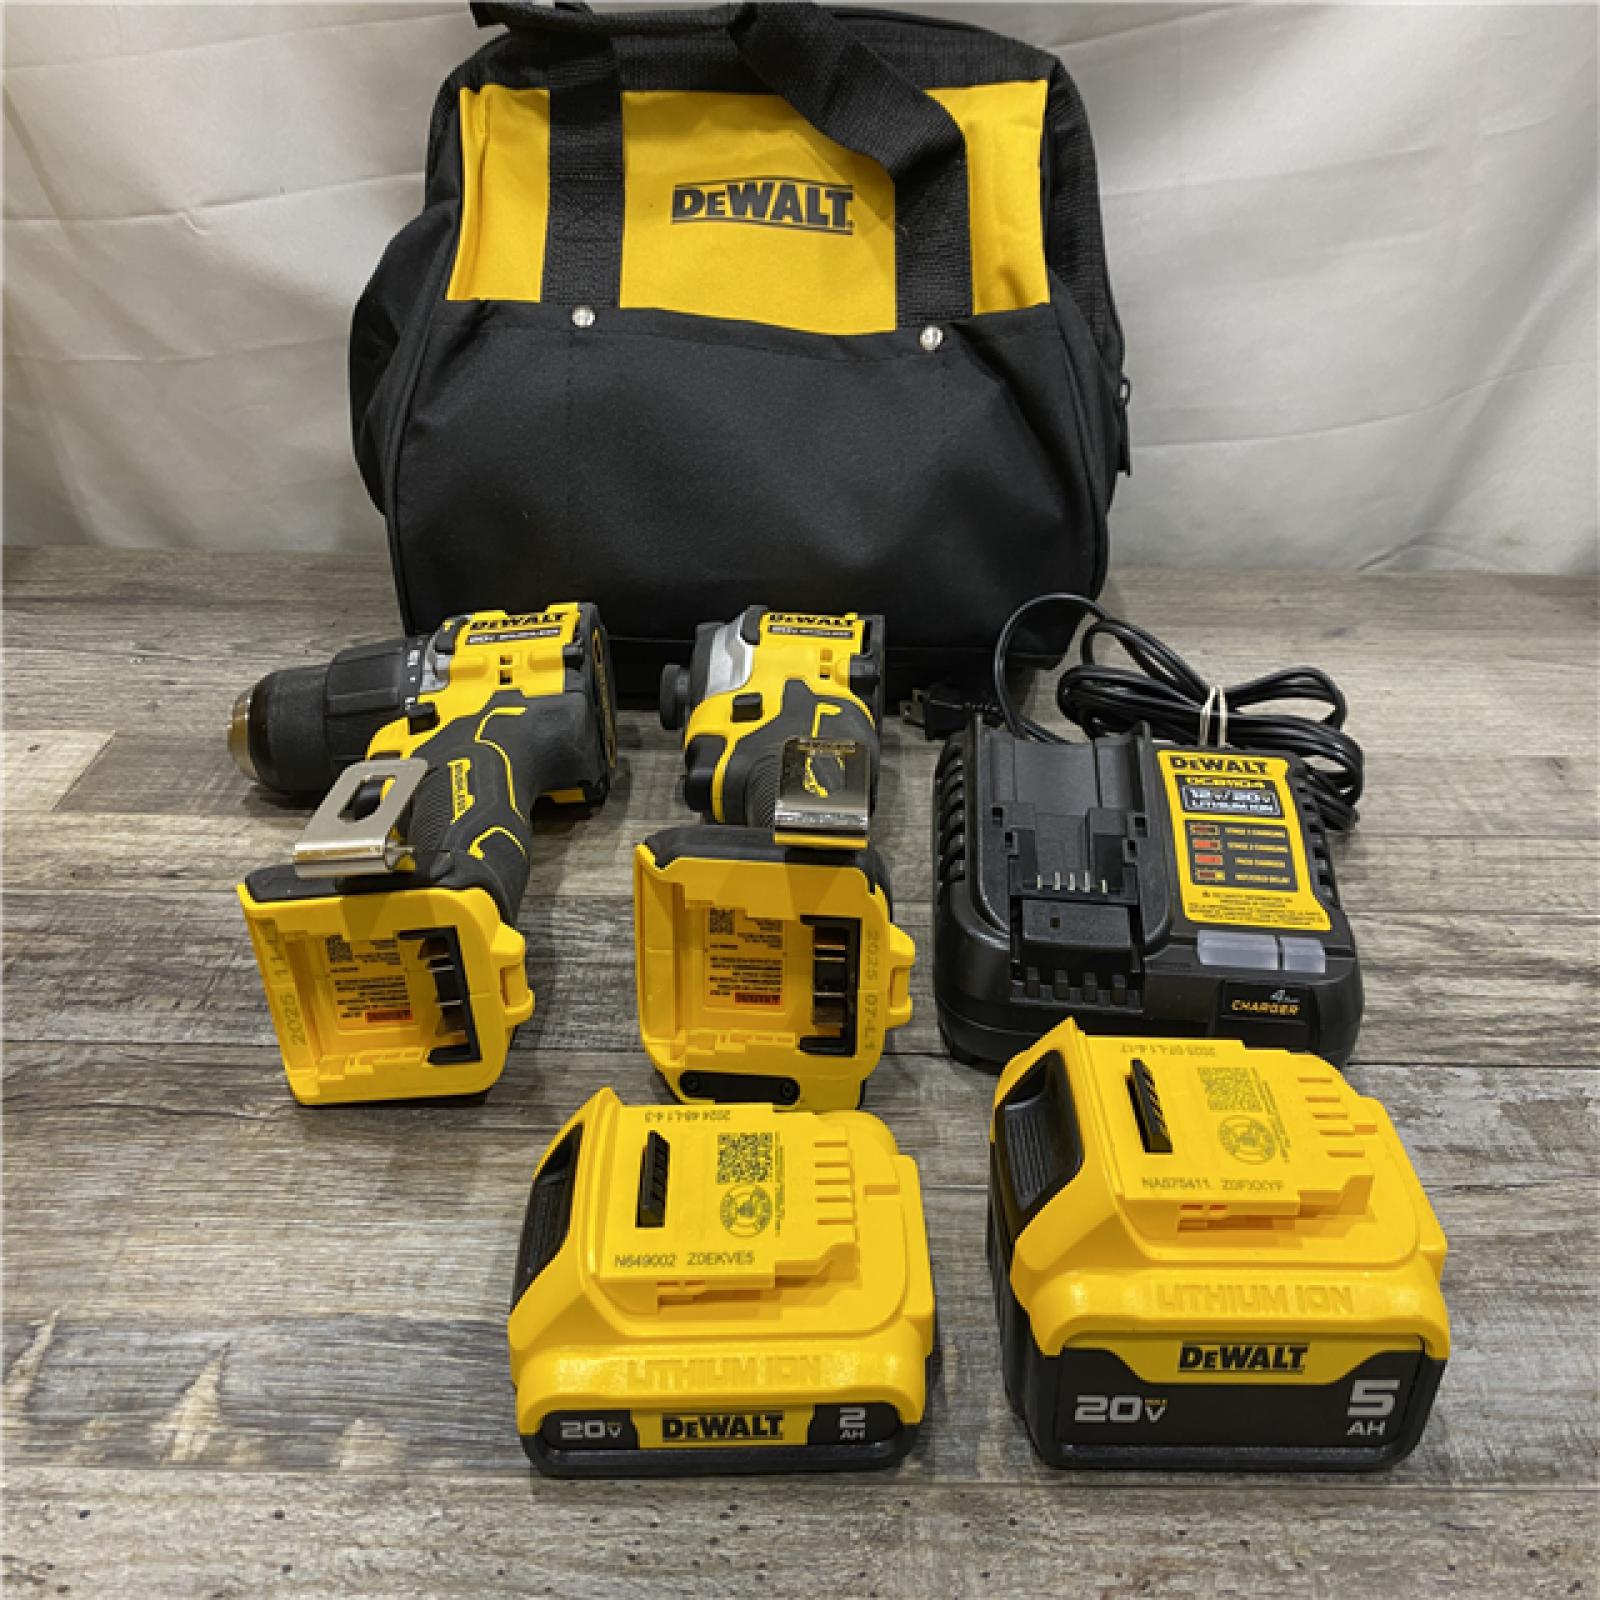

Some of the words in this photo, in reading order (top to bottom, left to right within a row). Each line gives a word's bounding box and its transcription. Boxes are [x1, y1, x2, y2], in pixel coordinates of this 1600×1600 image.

[672, 182, 853, 227] DEWALT
[1170, 756, 1268, 775] DEWALT
[865, 930, 880, 981] 2025
[1231, 999, 1300, 1016] CHARGER
[1154, 1284, 1290, 1314] LITHIUM
[1294, 1285, 1354, 1314] ION
[1178, 1346, 1309, 1370] DEWALT
[627, 1357, 757, 1390] LITHIUM
[763, 1356, 821, 1389] ION
[1346, 1378, 1401, 1417] 5
[661, 1414, 784, 1440] DEWALT
[838, 1407, 867, 1429] 2
[1346, 1419, 1386, 1437] AH
[839, 1429, 867, 1440] AH
